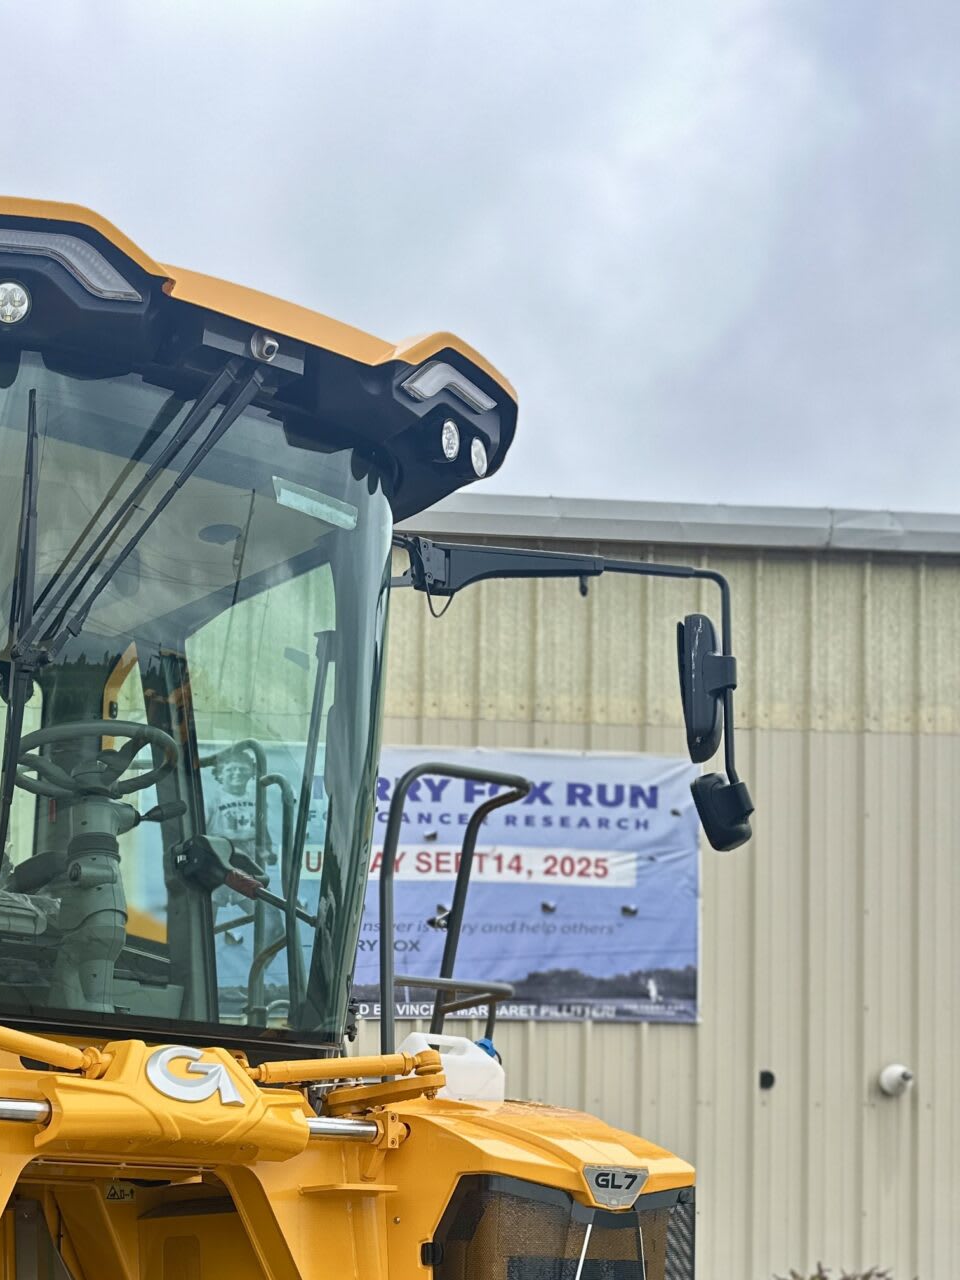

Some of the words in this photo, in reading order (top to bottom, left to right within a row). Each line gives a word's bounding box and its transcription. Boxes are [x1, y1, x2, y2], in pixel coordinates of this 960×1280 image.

[566, 782, 659, 809] RUN
[505, 815, 650, 831] RESEARCH
[543, 854, 609, 879] 2025
[393, 939, 421, 952] OX
[457, 1004, 537, 1016] MARARET
[595, 1172, 638, 1190] GL7
